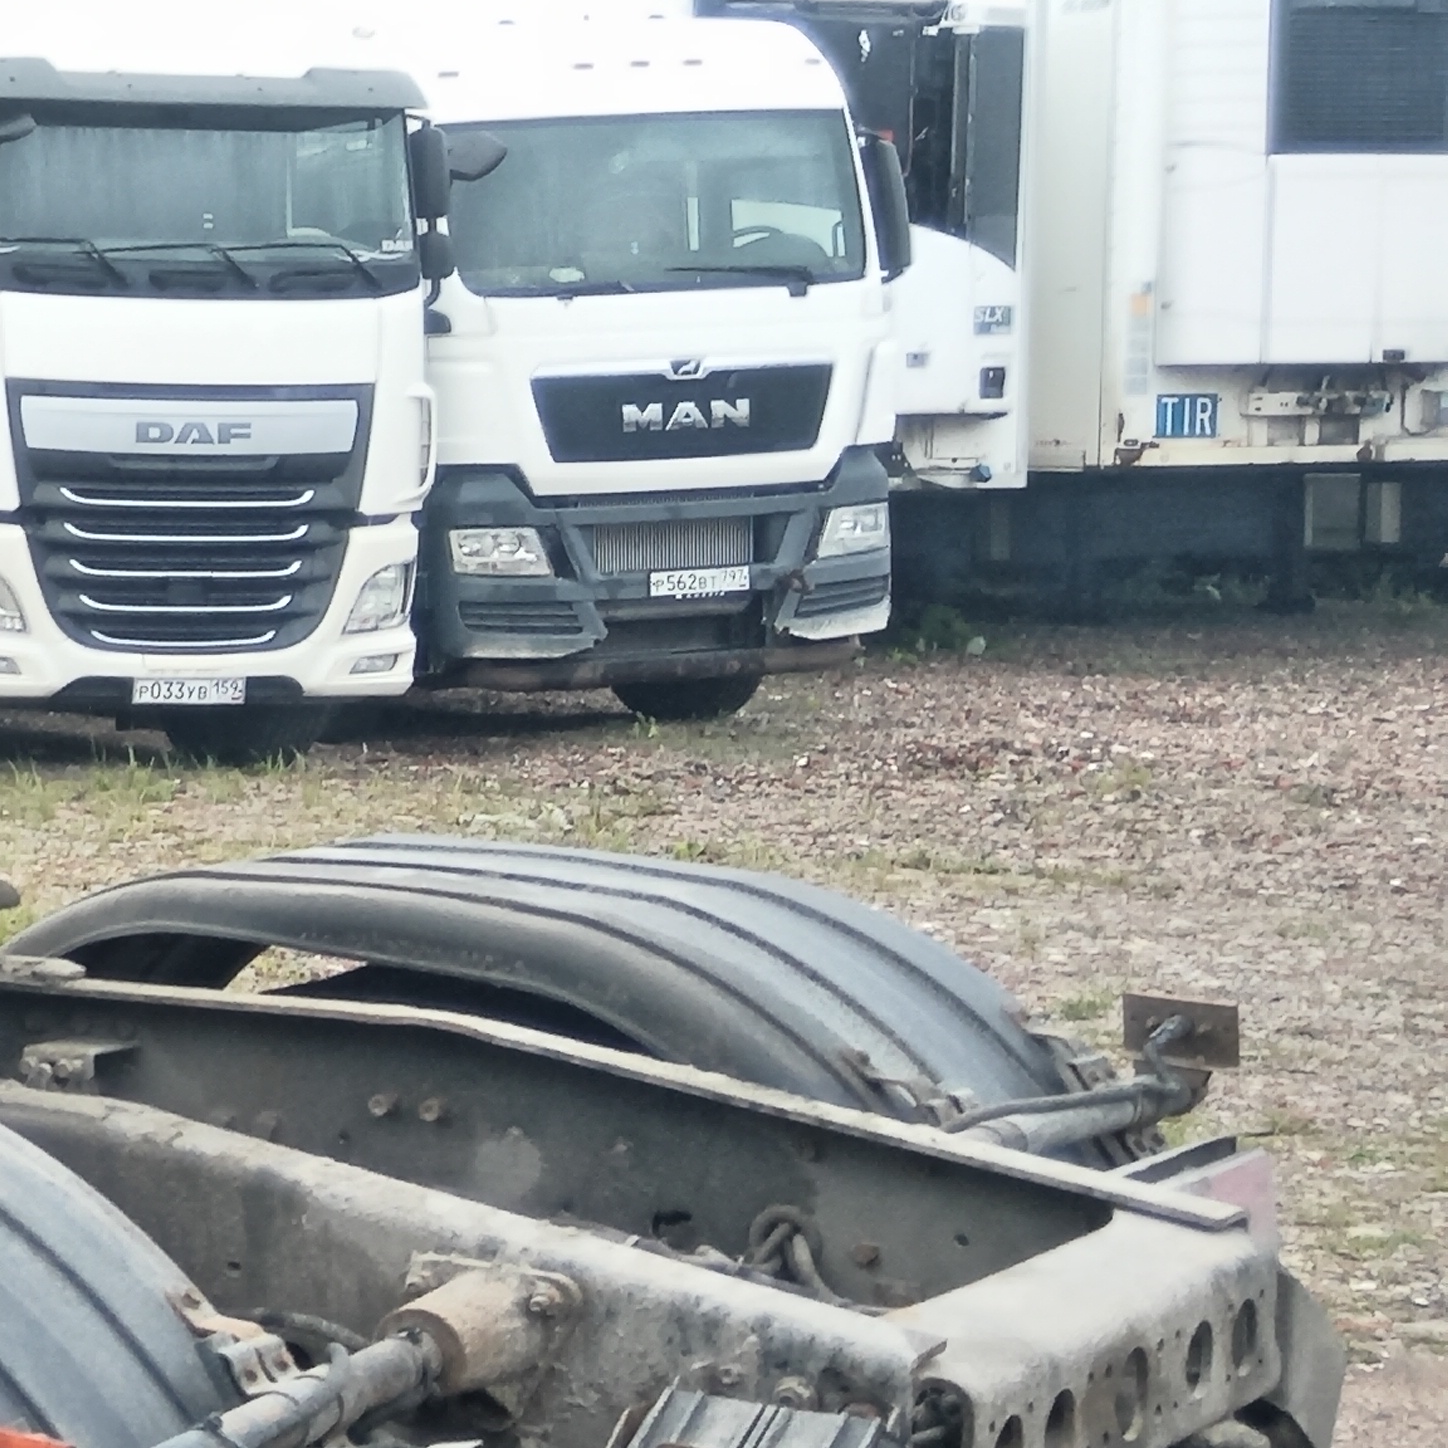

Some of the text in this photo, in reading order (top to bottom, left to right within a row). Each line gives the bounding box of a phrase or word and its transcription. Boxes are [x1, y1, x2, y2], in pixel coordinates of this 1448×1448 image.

[622, 398, 749, 432] MAN
[1161, 397, 1212, 436] TIR
[135, 422, 252, 445] DAF
